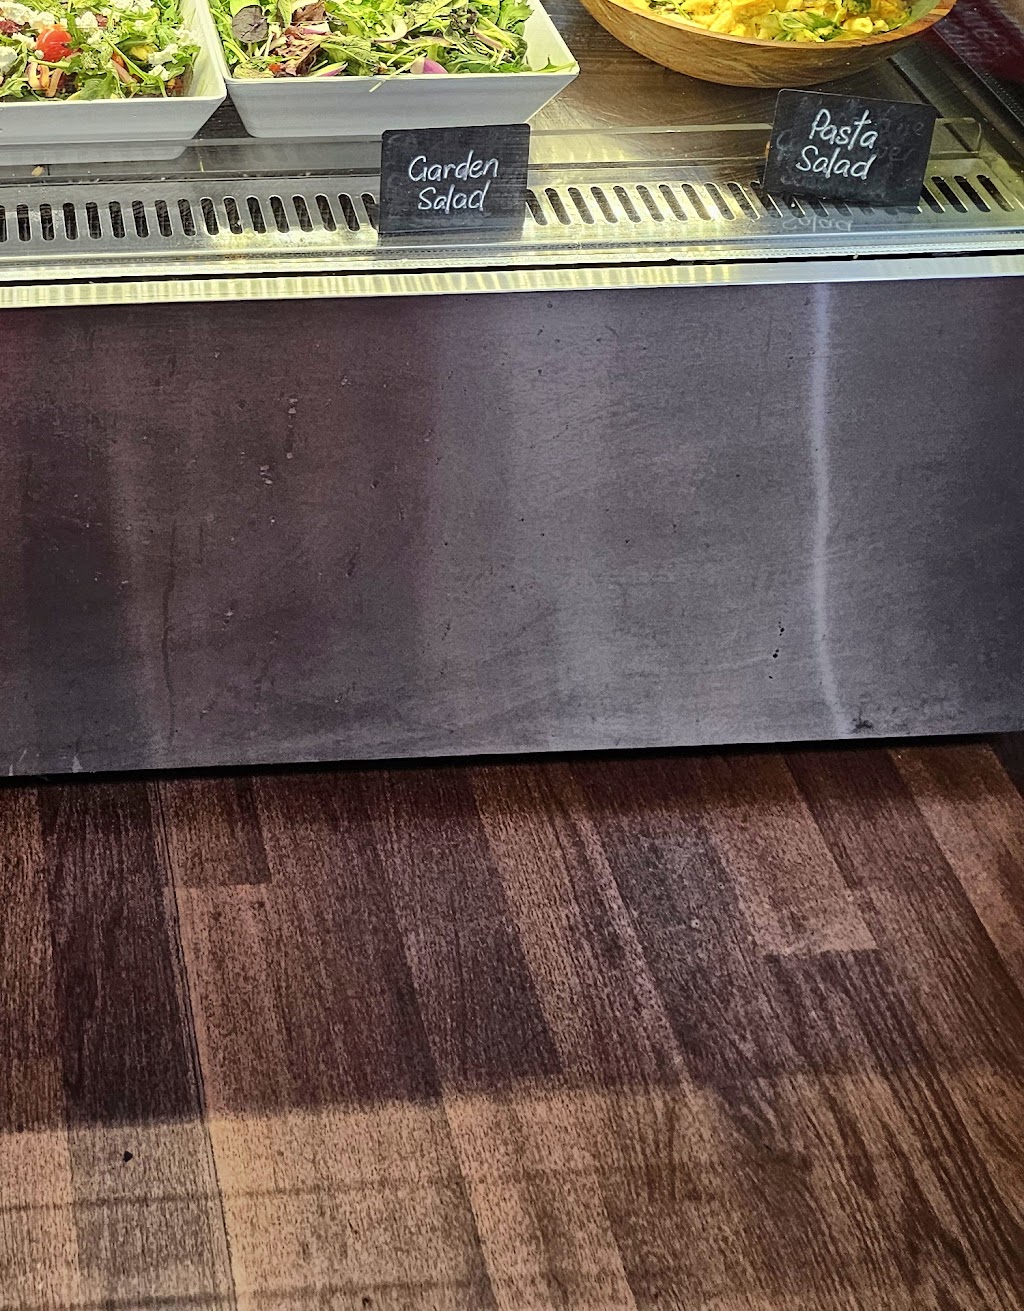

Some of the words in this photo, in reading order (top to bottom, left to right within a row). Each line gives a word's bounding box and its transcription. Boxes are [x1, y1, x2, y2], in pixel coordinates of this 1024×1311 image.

[809, 108, 878, 150] Pasta
[408, 149, 499, 182] Garden
[795, 145, 877, 180] Salad
[417, 179, 491, 214] Salad
